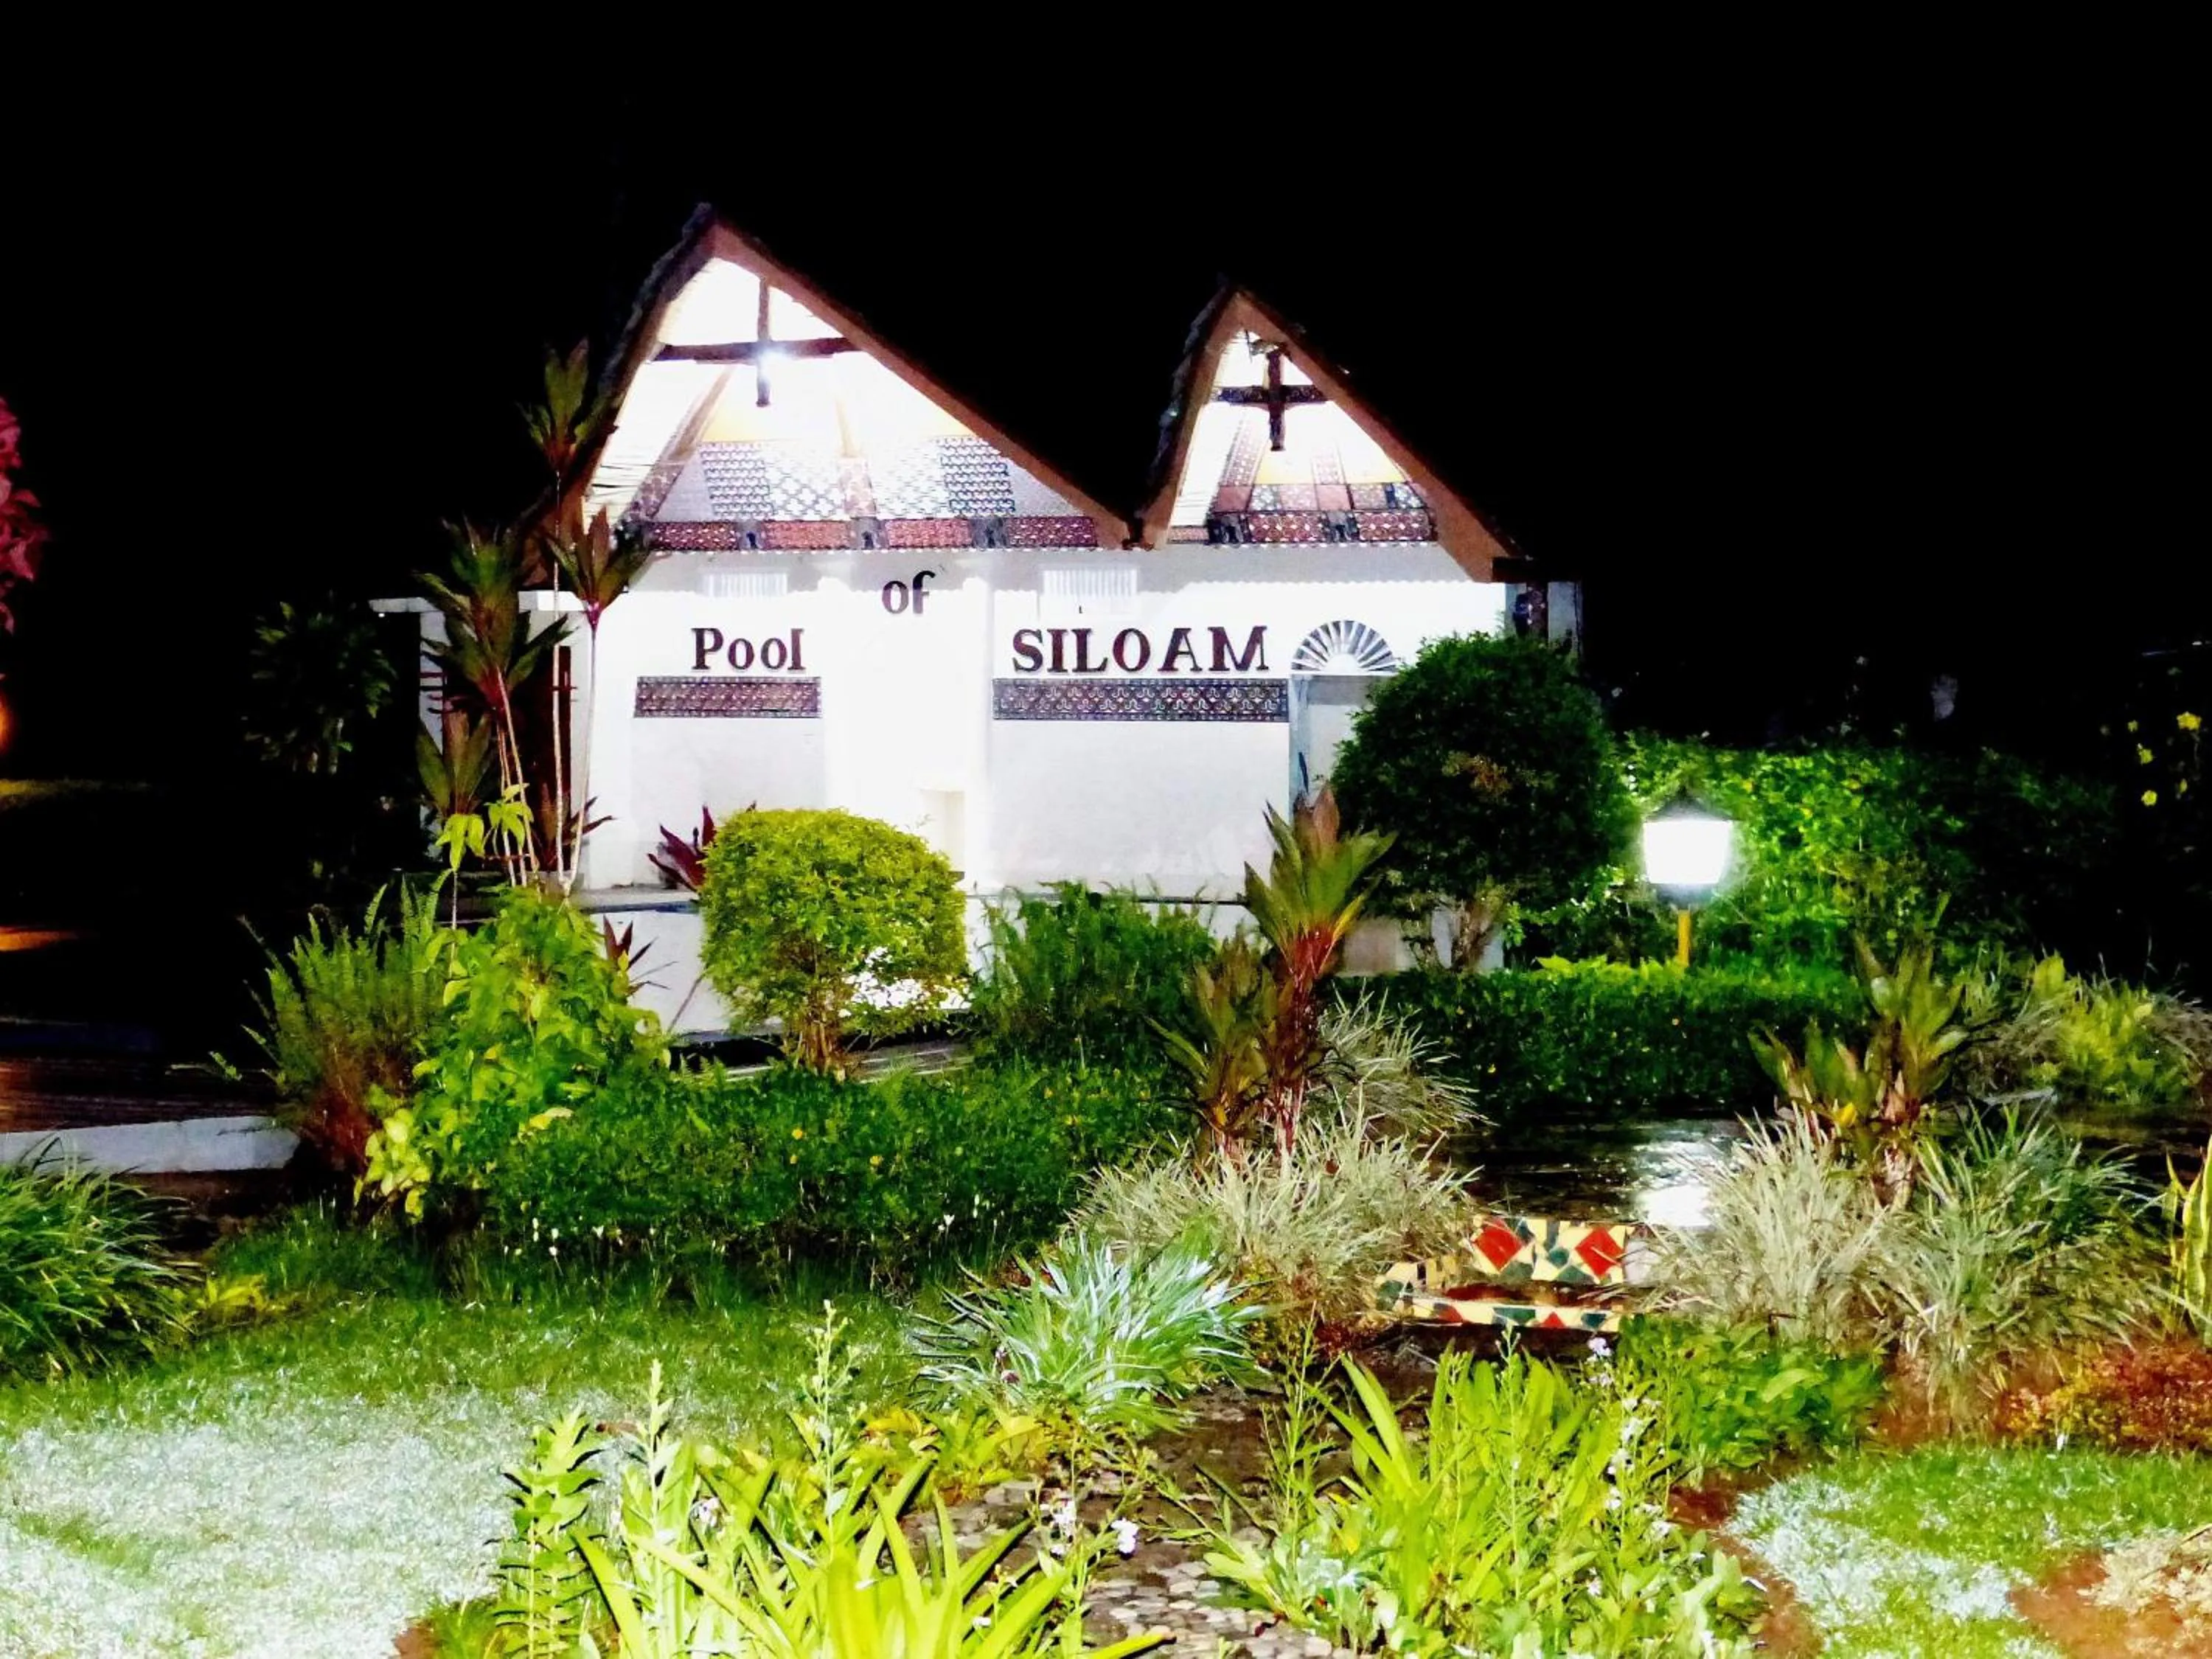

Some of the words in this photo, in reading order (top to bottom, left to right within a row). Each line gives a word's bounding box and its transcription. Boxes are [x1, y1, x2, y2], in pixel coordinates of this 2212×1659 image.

[689, 627, 807, 671] Pool
[881, 569, 937, 614] of
[1012, 626, 1270, 673] SILOAM
